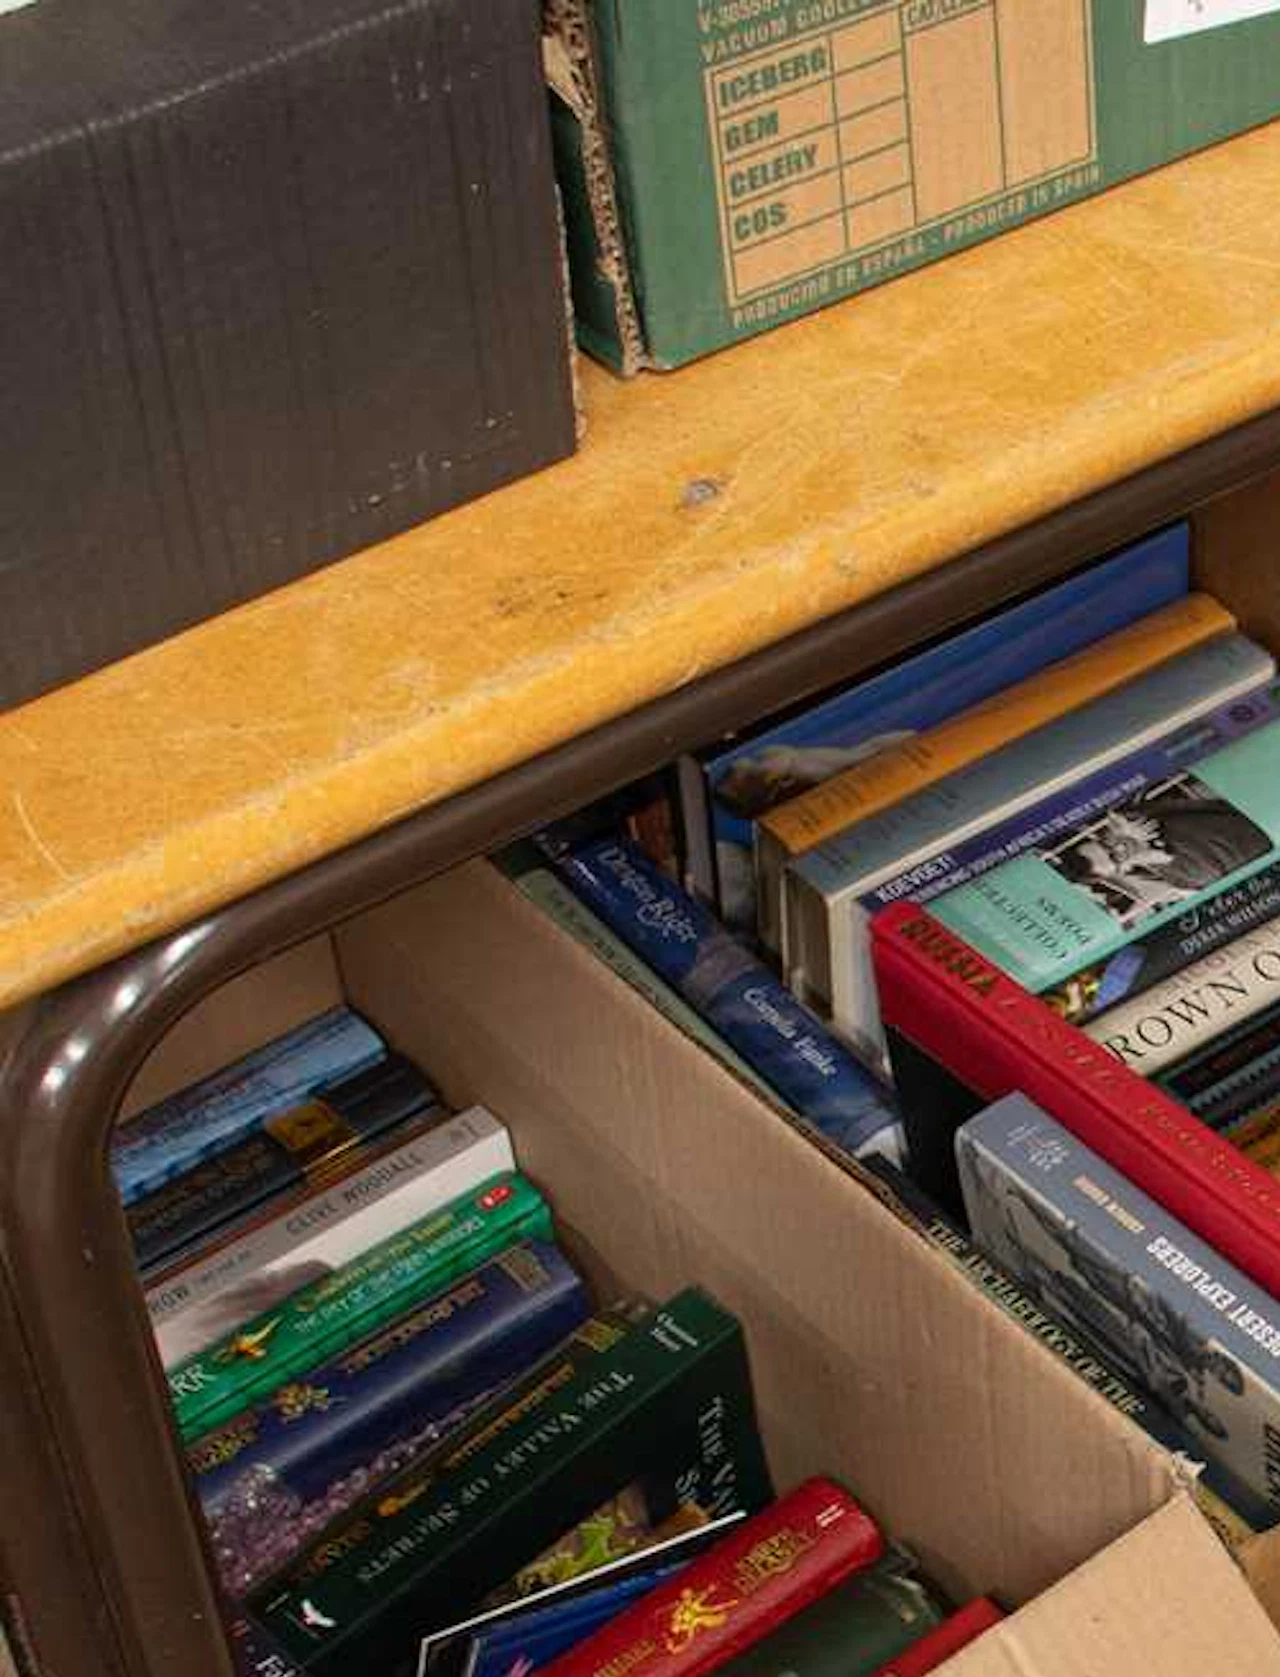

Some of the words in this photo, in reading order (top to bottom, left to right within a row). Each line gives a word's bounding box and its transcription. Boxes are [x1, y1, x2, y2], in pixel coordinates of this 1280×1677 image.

[718, 46, 828, 108] ICEBERG
[725, 110, 780, 153] GEM
[729, 143, 820, 199] CELERY
[734, 202, 788, 241] COS
[899, 917, 999, 996] RUSSIA
[1104, 972, 1250, 1064] ROWN
[1143, 1233, 1238, 1311] EXPLORERS
